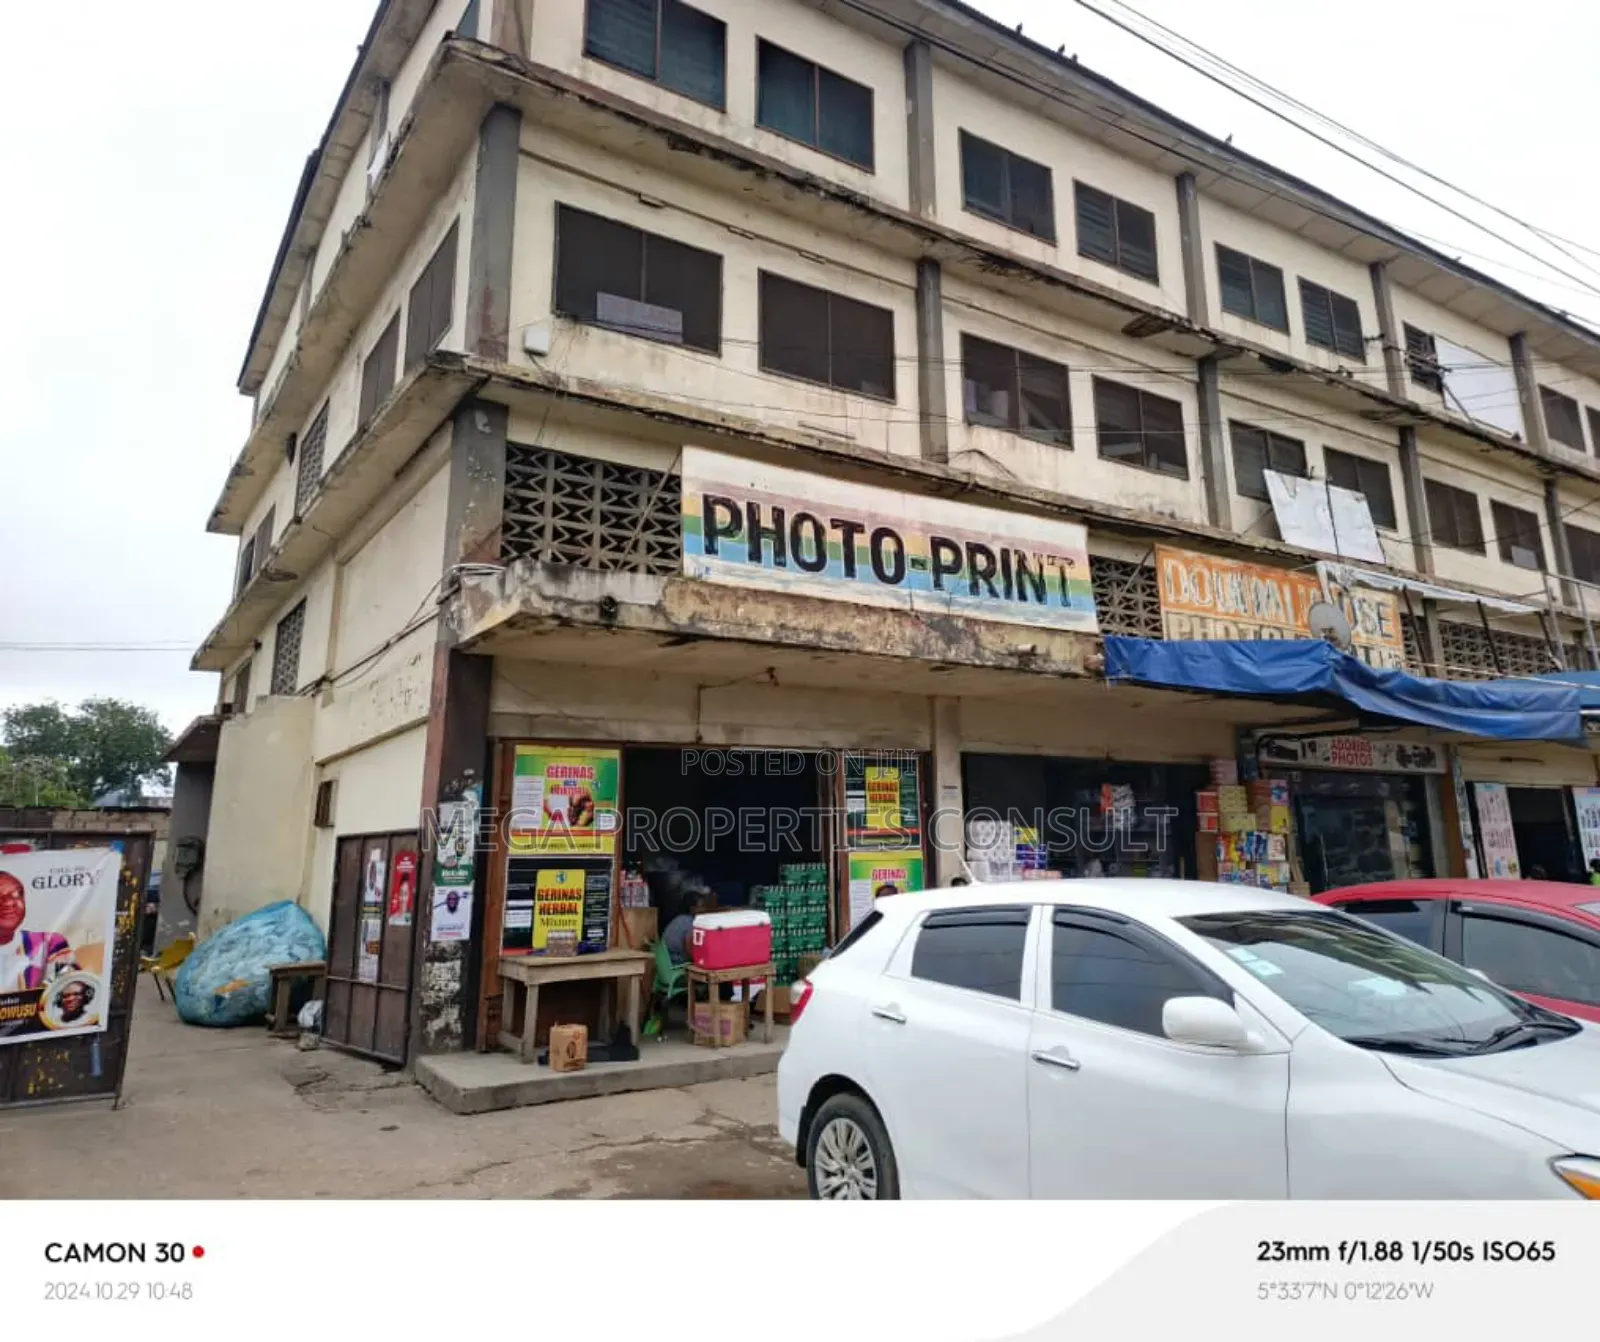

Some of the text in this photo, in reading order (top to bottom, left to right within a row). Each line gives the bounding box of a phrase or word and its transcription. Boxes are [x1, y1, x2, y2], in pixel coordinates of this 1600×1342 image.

[1331, 750, 1372, 767] PHOTOS
[32, 870, 101, 890] GLORY
[537, 887, 582, 901] GERINAS
[539, 902, 578, 916] HERBAL
